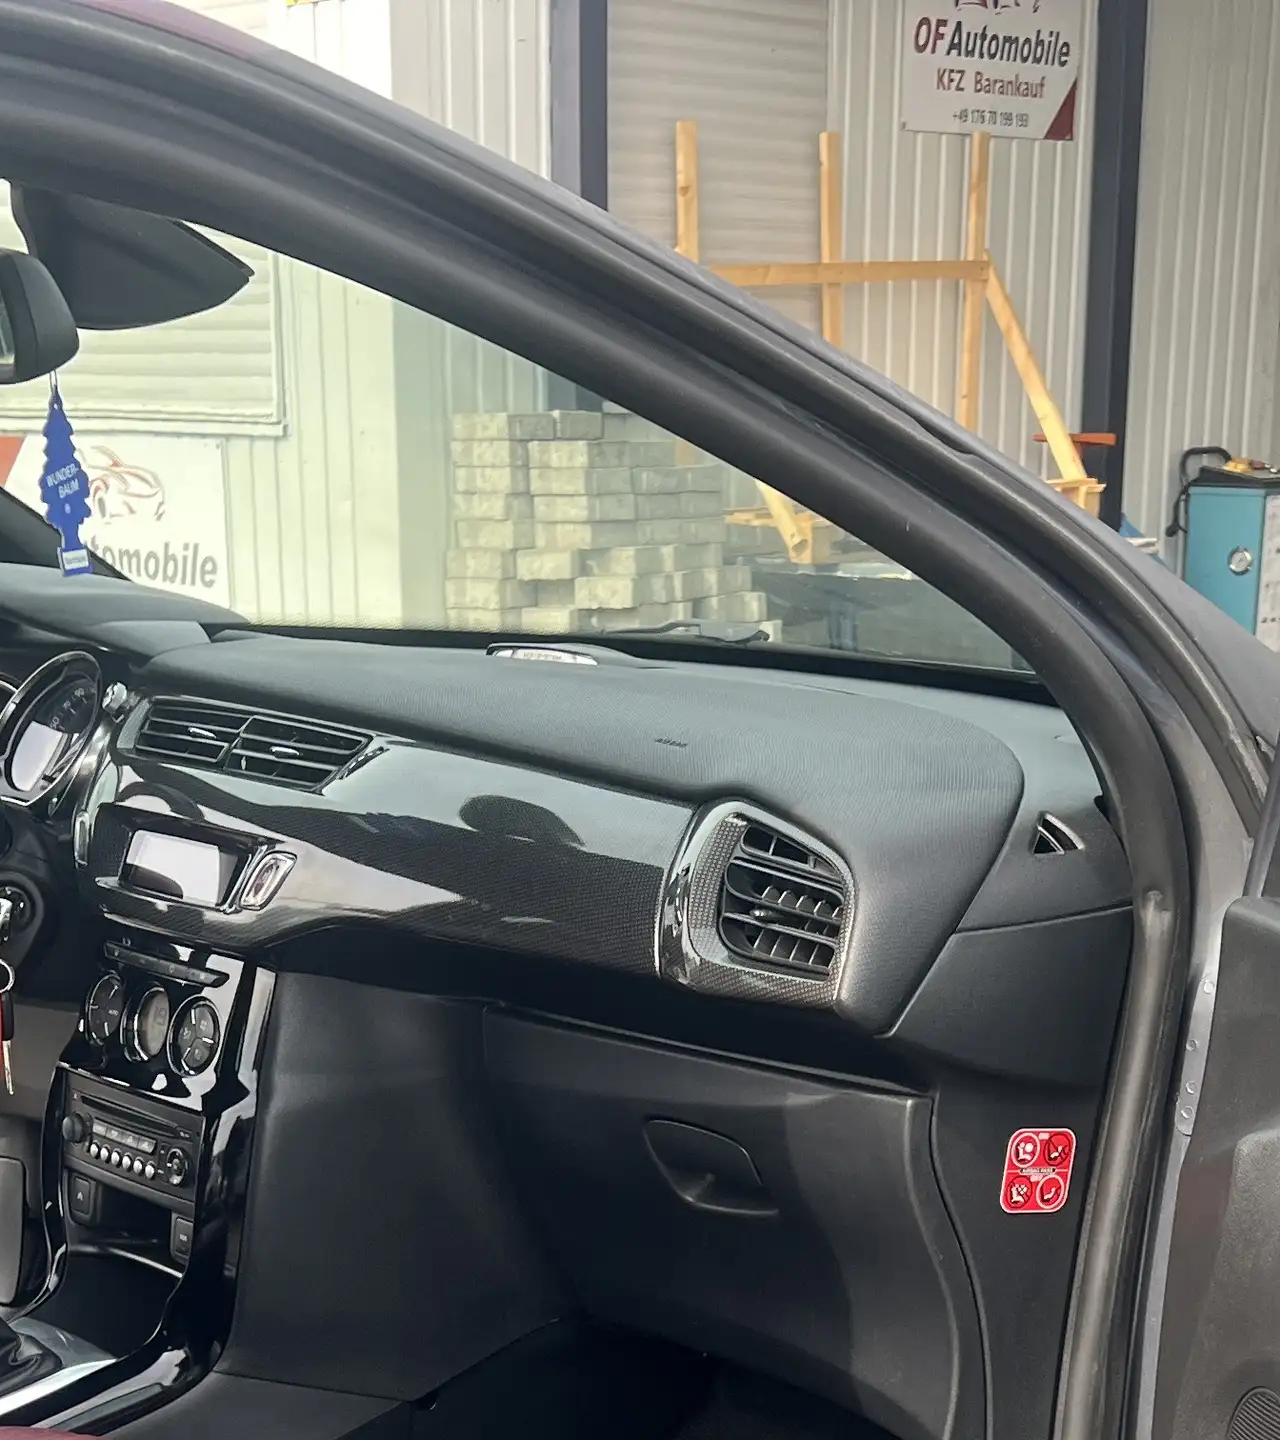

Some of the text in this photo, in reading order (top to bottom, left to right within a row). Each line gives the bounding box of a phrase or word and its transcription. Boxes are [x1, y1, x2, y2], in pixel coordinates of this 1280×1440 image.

[936, 67, 1047, 98] KFZ Barankauf
[58, 478, 80, 498] BAUM
